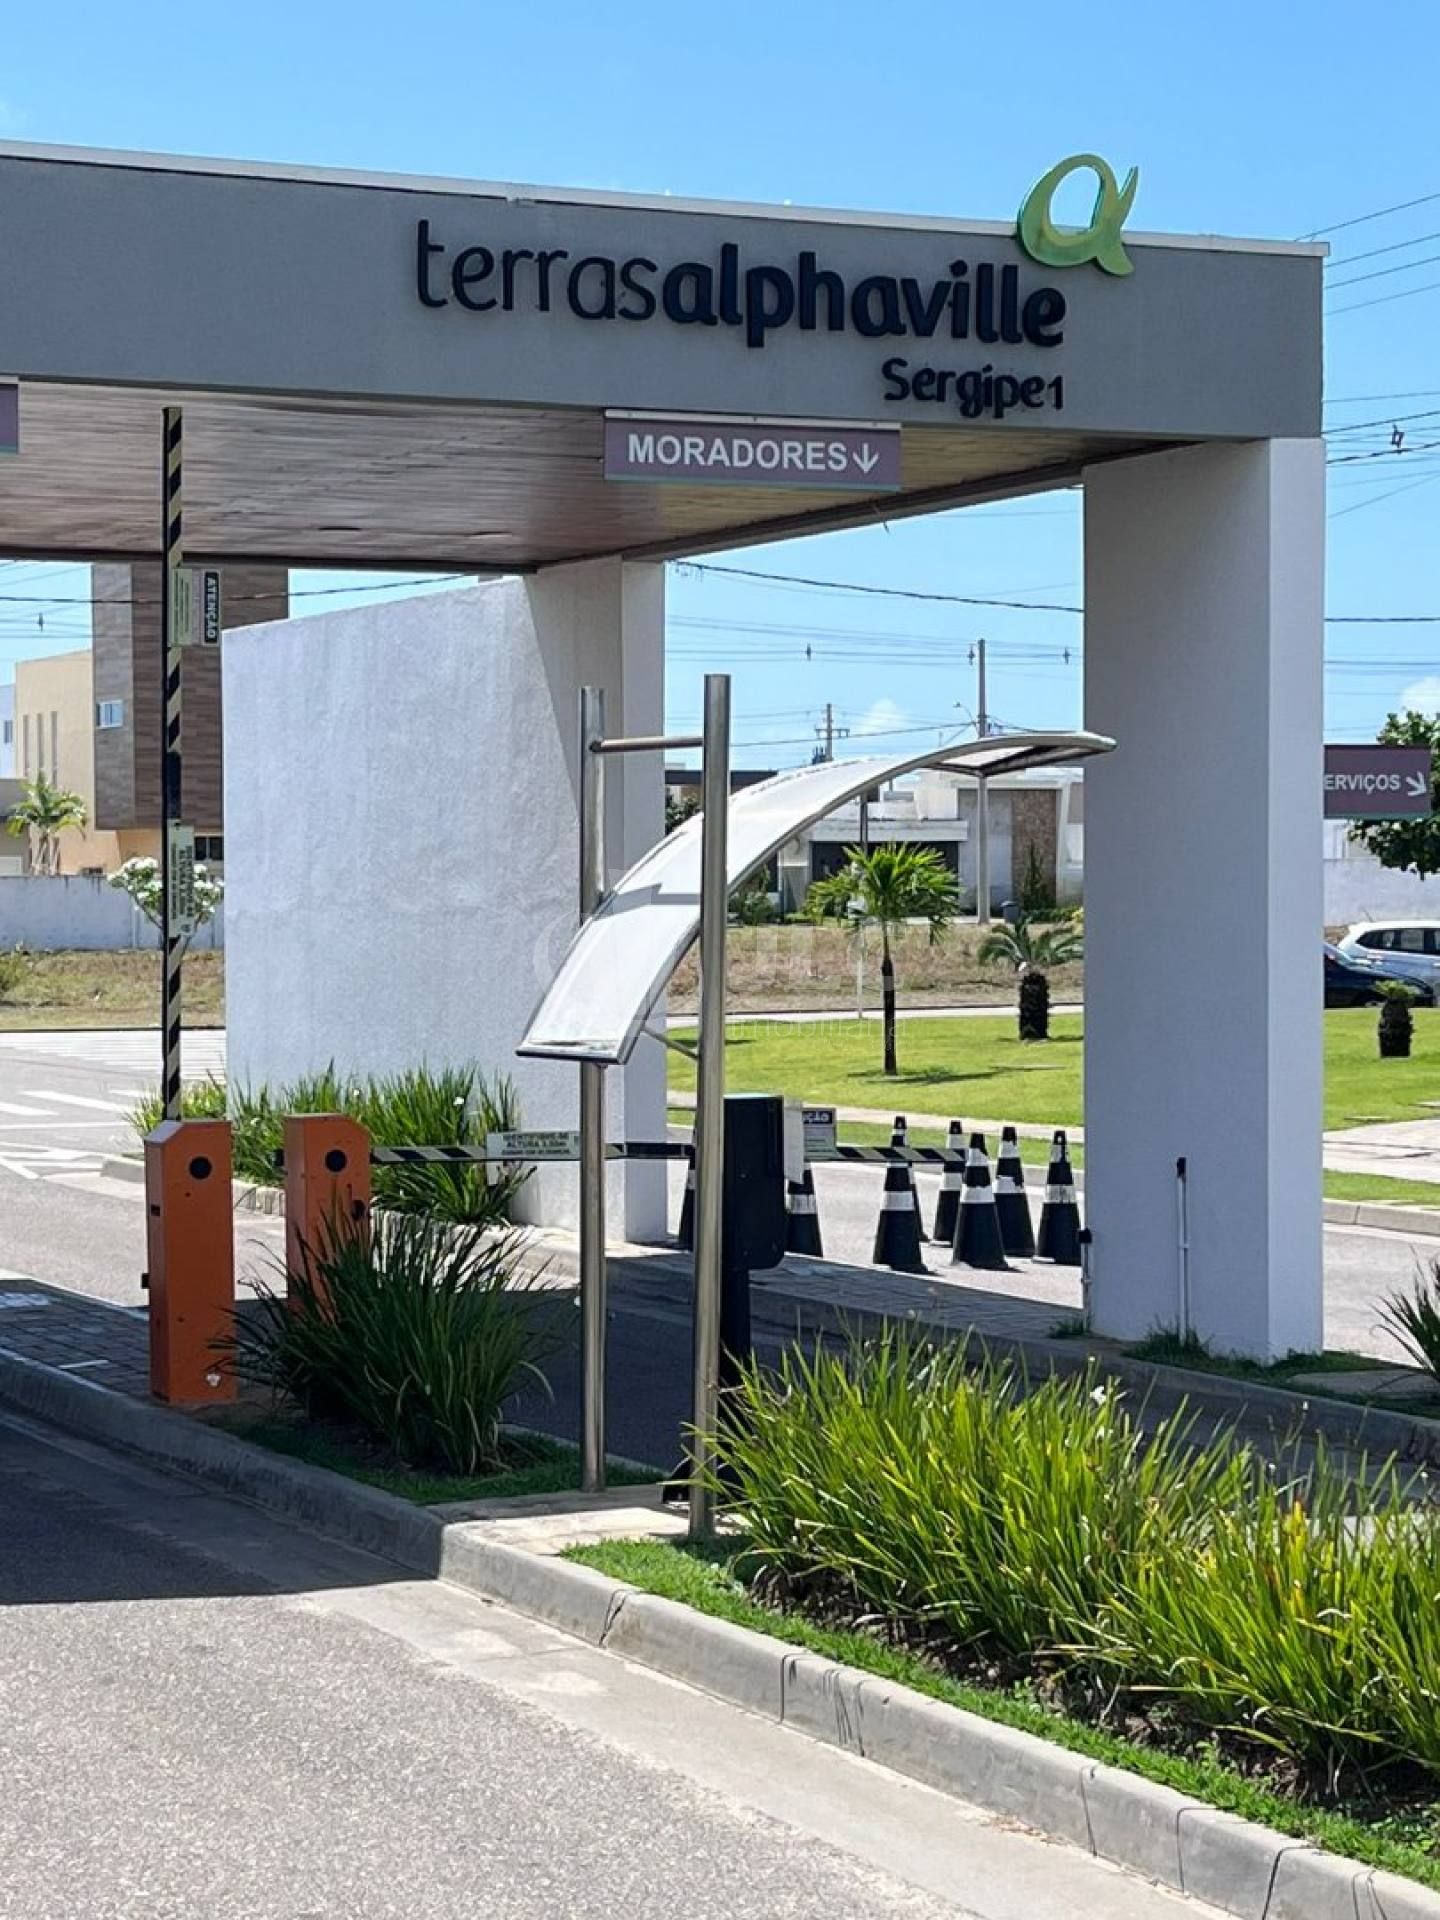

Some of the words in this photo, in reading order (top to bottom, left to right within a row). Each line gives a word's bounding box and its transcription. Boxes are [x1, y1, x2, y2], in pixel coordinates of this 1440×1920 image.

[626, 433, 848, 472] MORADORES
[206, 577, 218, 640] ATENÇÃO
[1324, 773, 1401, 795] ERVIÇOS
